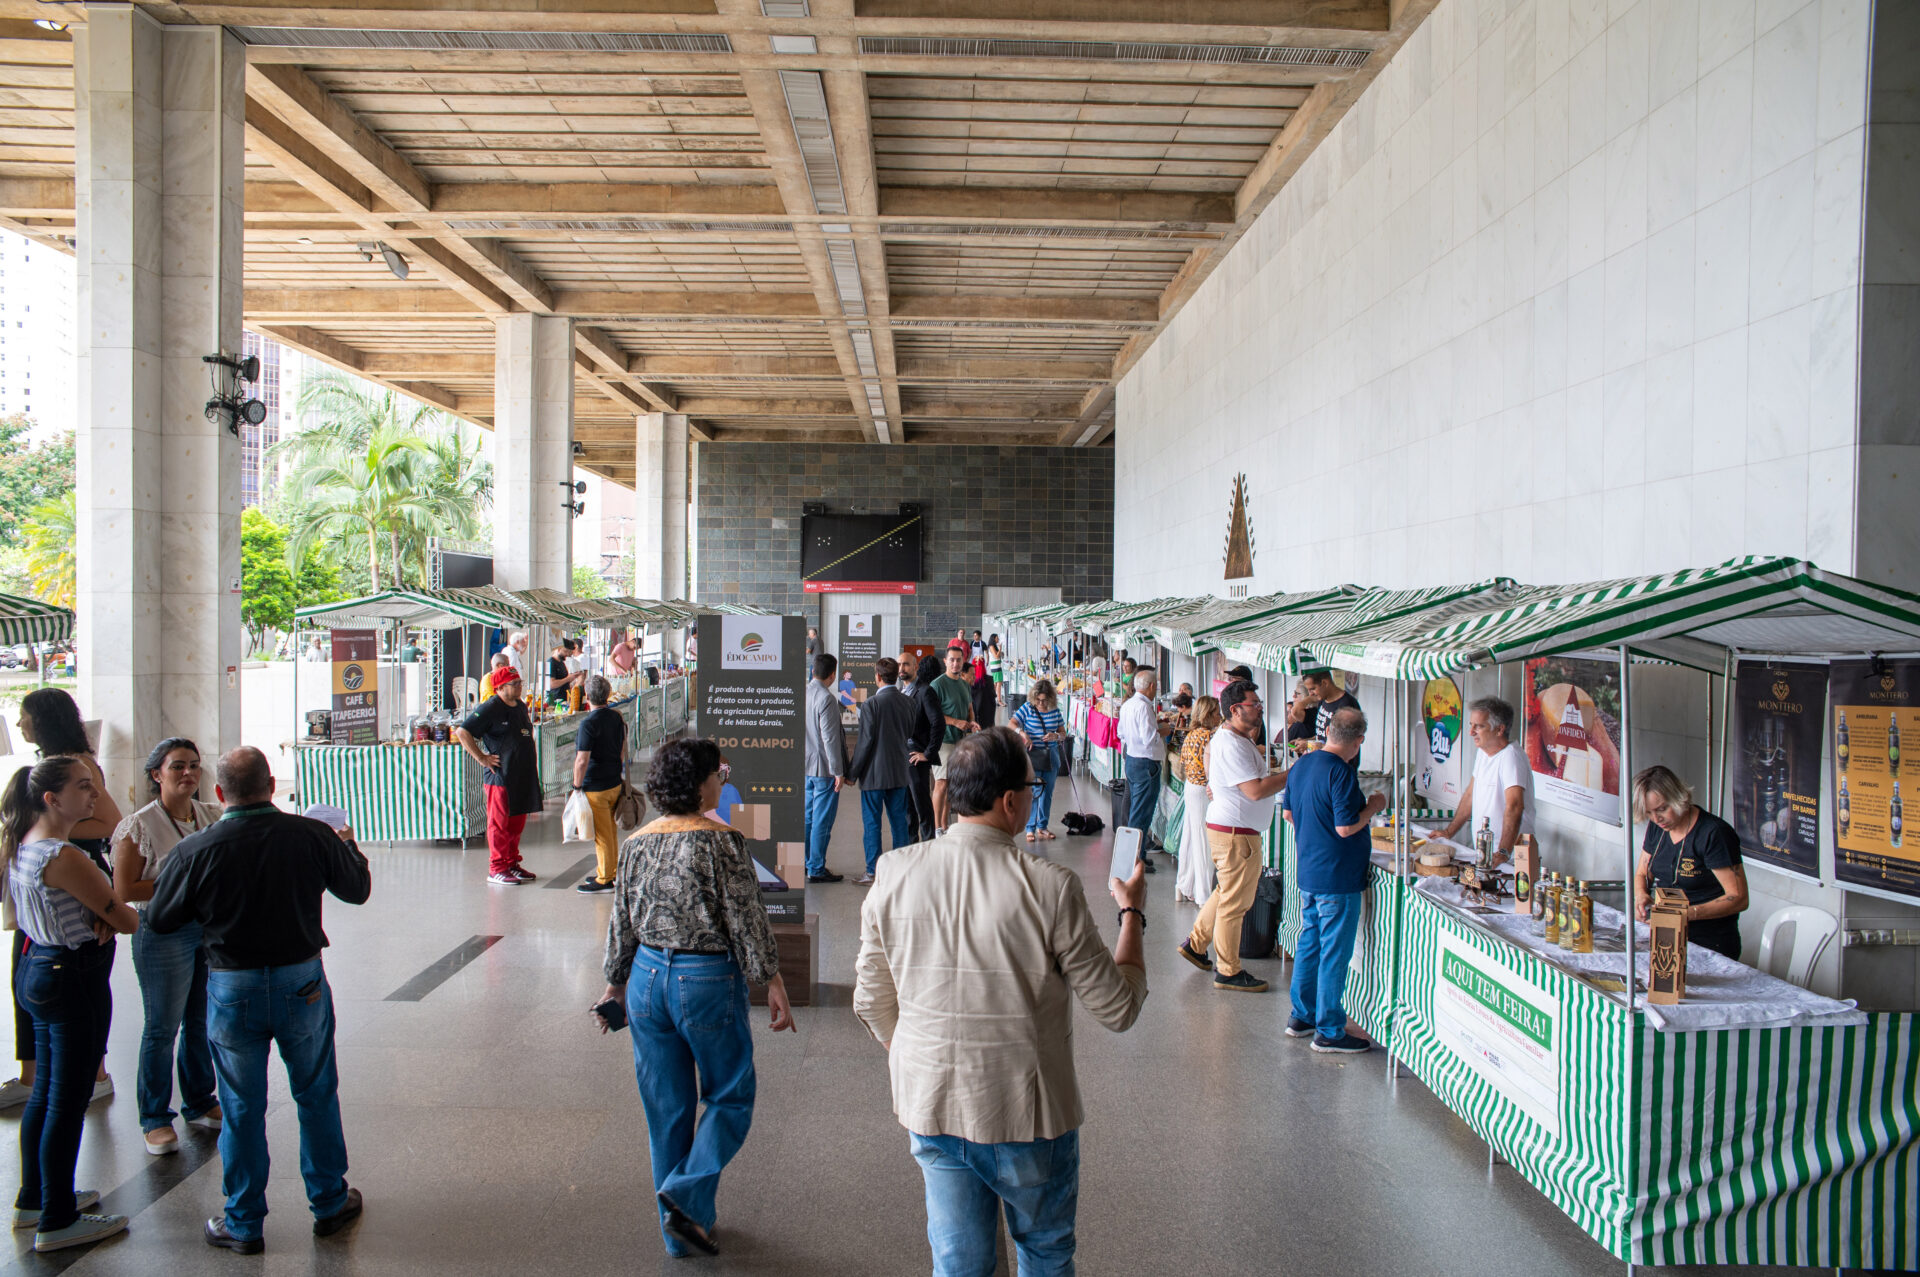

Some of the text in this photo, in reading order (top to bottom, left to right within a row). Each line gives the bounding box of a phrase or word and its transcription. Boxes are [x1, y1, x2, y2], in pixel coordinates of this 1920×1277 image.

[708, 684, 714, 692] É
[715, 686, 744, 694] produto
[756, 686, 794, 695] qualidade,
[345, 693, 364, 706] CAFÉ
[1870, 691, 1909, 700] MONTTERO
[760, 697, 794, 706] produtor,
[1758, 700, 1803, 713] MONTTERO
[331, 707, 376, 720] ITAPECERICA
[706, 706, 711, 714] É
[724, 708, 764, 716] agricultura
[764, 708, 796, 716] familiar,
[724, 718, 734, 726] de
[759, 719, 784, 727] Gerais,
[720, 738, 738, 748] DO
[742, 738, 794, 749] CAMPO!
[1431, 728, 1450, 754] Blu
[1782, 792, 1816, 806] ENVELHECIDAS
[1800, 805, 1816, 816] BARRIS
[1445, 957, 1546, 1040] AQUI TEM FEIRA!
